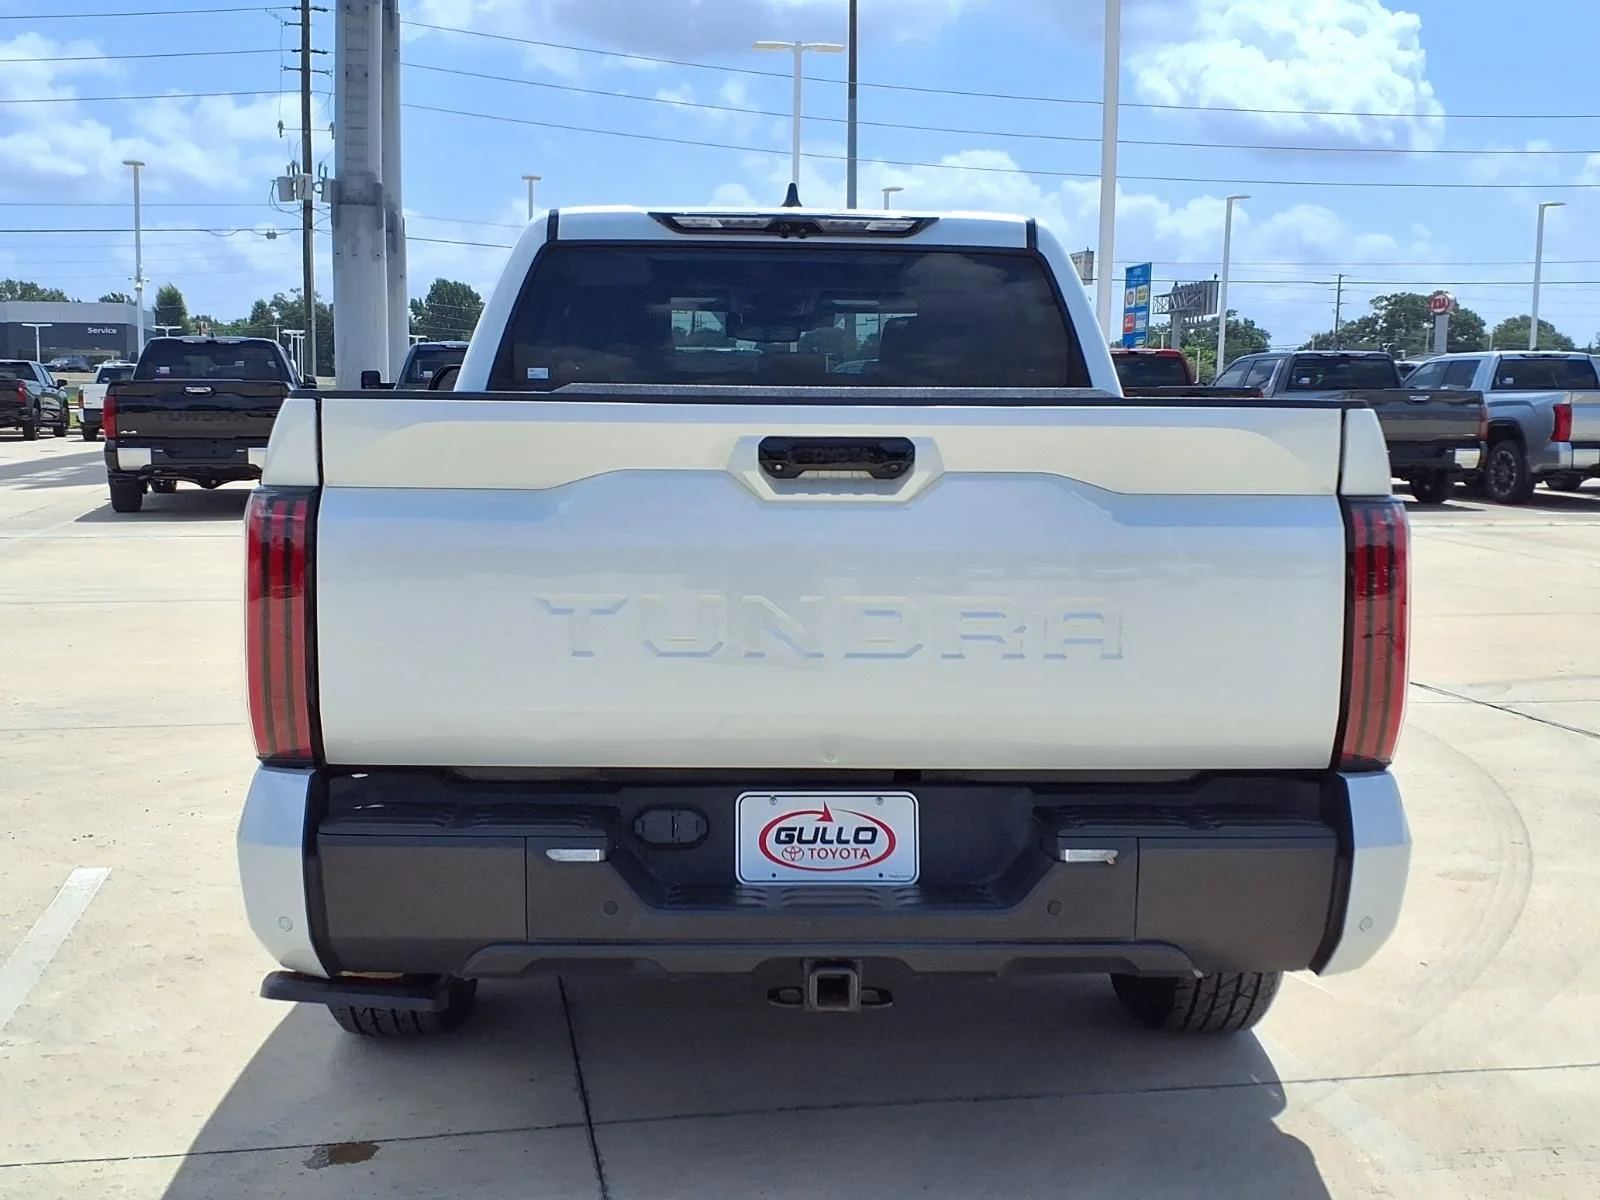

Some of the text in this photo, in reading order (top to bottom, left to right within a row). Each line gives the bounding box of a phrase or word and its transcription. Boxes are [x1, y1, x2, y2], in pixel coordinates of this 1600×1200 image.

[87, 326, 118, 334] Service
[156, 411, 248, 422] TUNDRA
[535, 593, 1124, 660] TUNDRA
[775, 826, 878, 845] GULLO
[807, 847, 871, 860] TOYOTA
